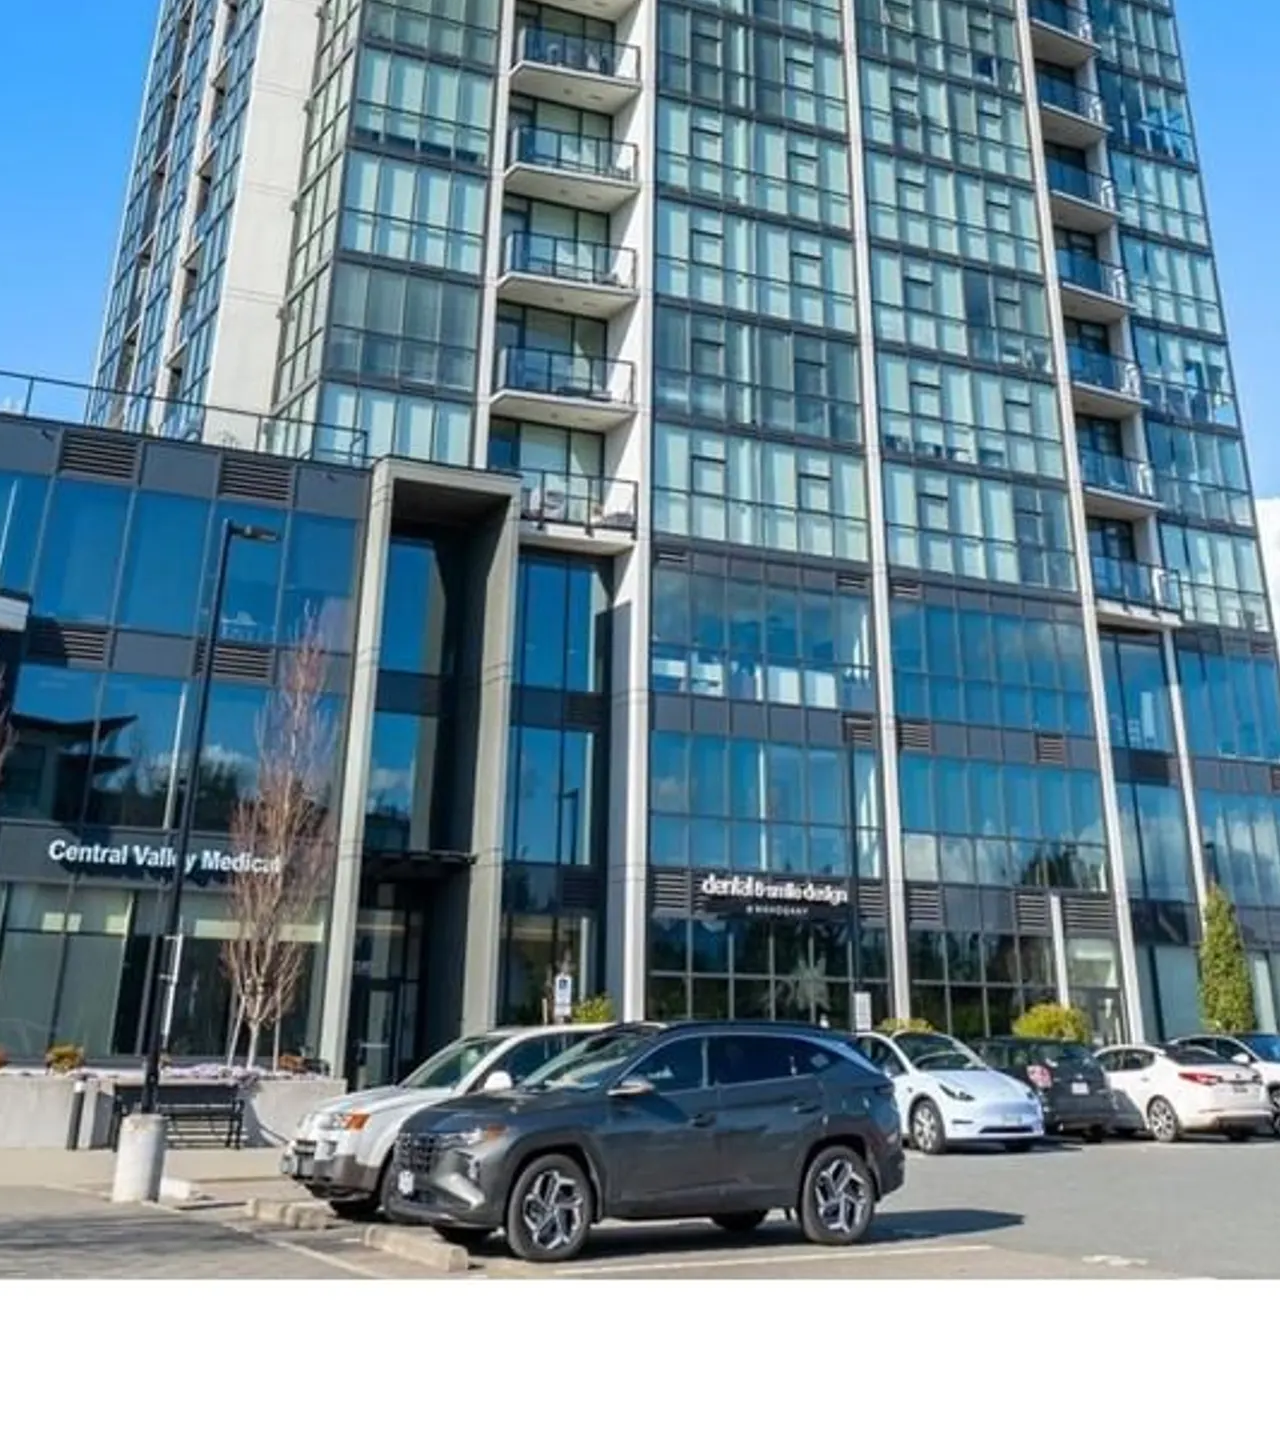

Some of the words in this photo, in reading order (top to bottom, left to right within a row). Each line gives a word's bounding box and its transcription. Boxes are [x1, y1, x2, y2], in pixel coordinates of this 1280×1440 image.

[48, 839, 128, 866] Central
[201, 850, 282, 874] Medical
[702, 873, 754, 897] dental
[803, 883, 848, 906] design
